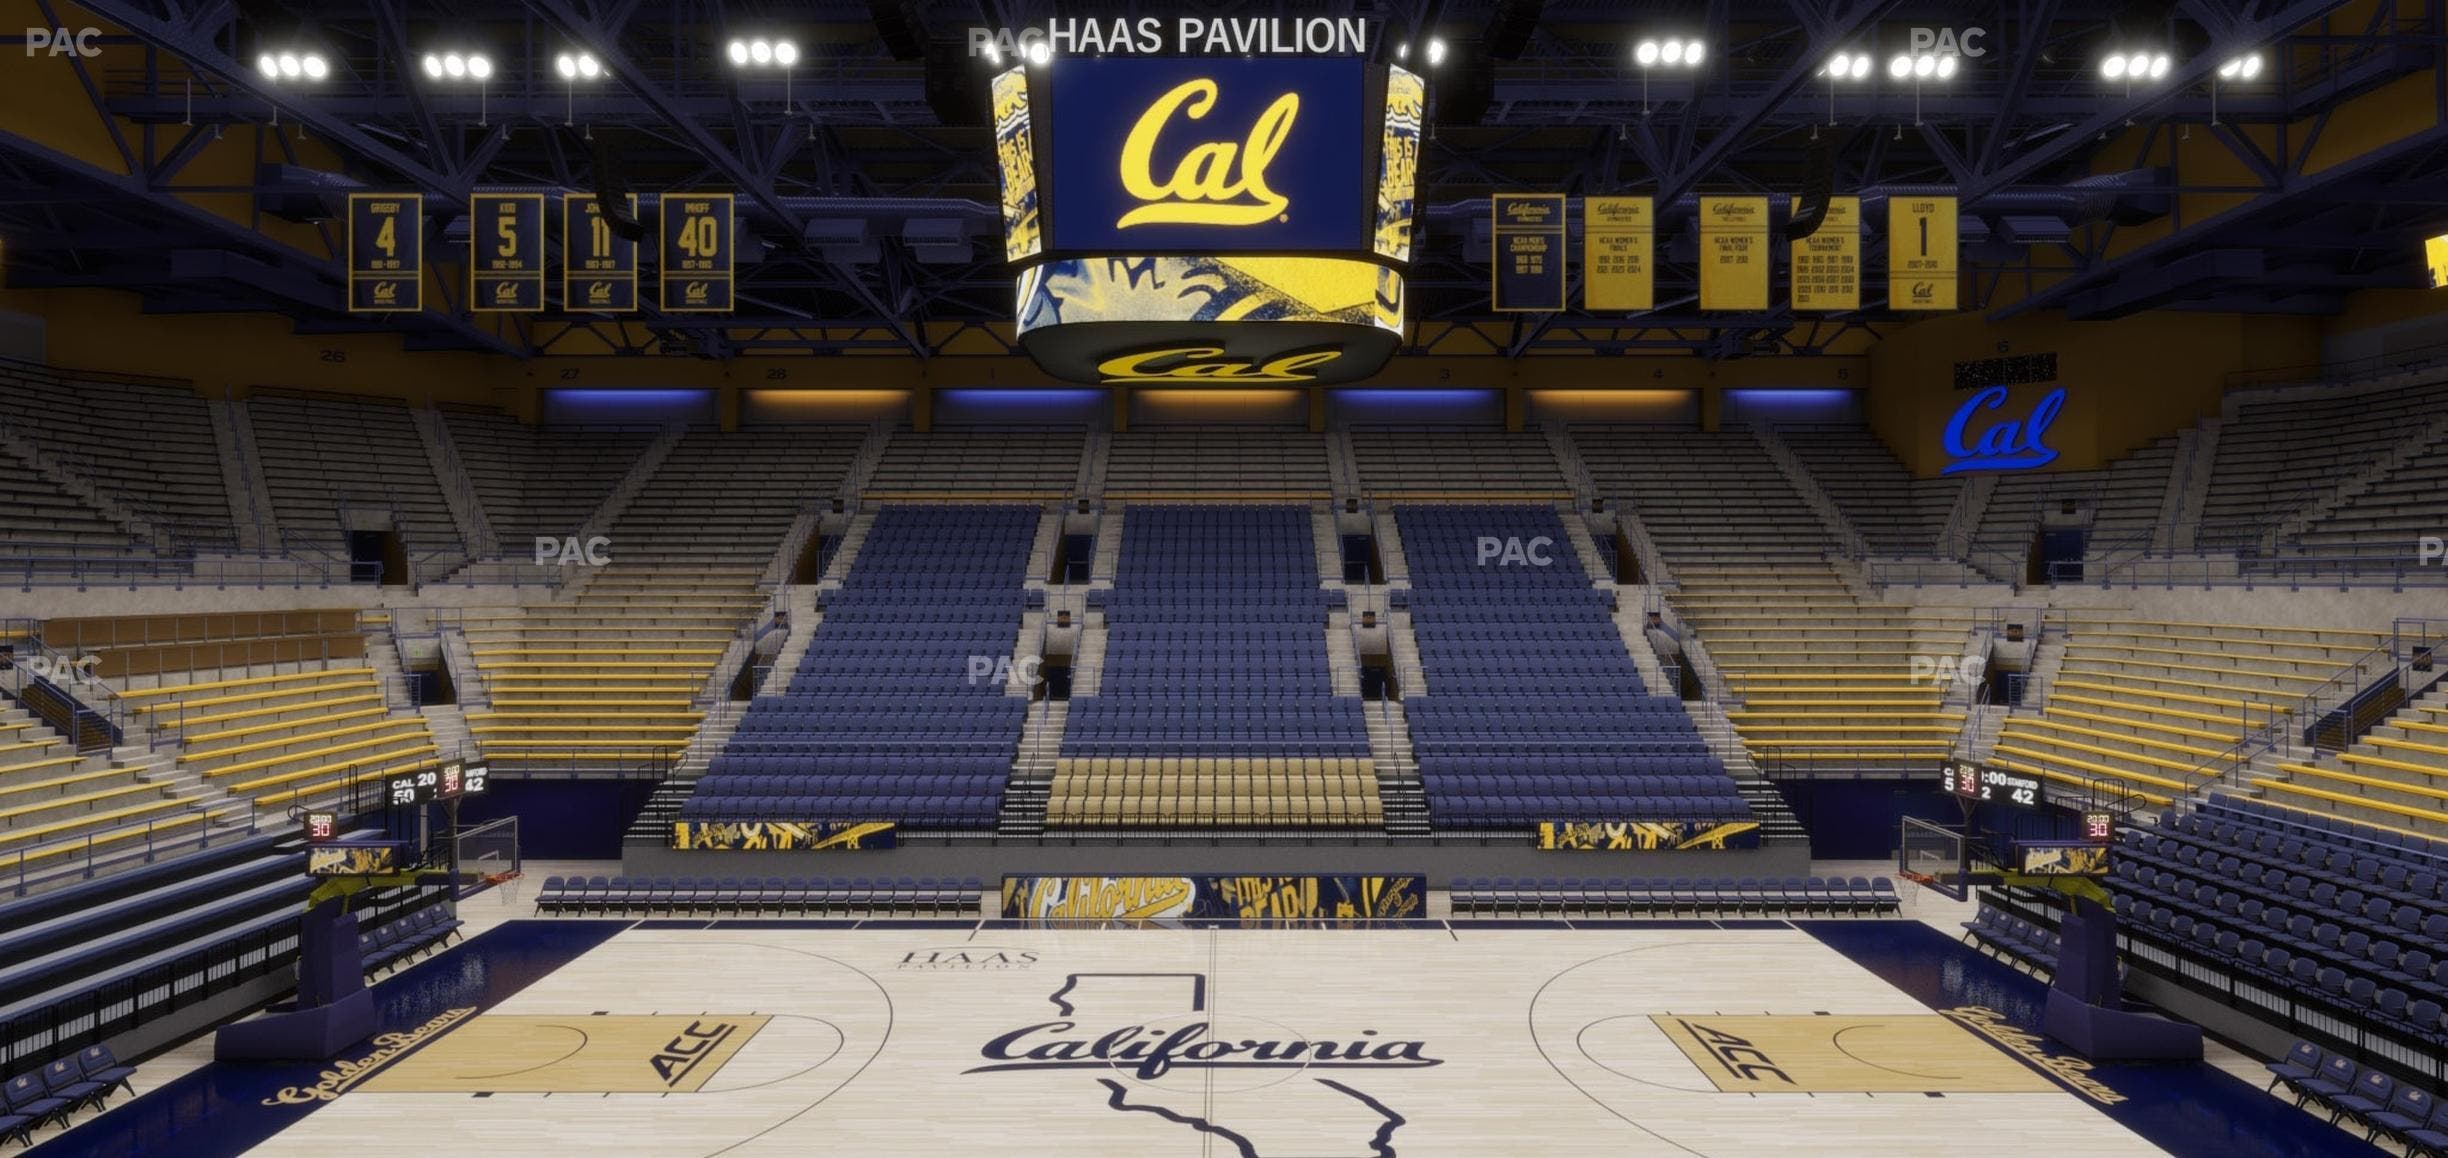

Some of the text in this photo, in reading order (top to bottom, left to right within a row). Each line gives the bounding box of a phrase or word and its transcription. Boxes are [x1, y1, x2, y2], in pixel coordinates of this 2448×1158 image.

[1049, 18, 1365, 53] HAAS PAVILION
[1116, 78, 1299, 229] Cal
[376, 217, 395, 257] 4
[498, 216, 517, 257] 5
[592, 216, 610, 257] 11
[678, 216, 718, 257] 40
[1920, 217, 1927, 257] 1
[374, 281, 397, 299] Cal
[496, 281, 519, 299] Cal
[589, 281, 612, 299] Cal
[685, 281, 709, 299] Cal
[1912, 282, 1934, 298] Cal
[1098, 347, 1342, 383] Cal
[1940, 385, 2067, 475] Cal
[392, 779, 416, 790] CAL
[464, 778, 485, 792] 42
[1944, 777, 2035, 806] 5 2 42
[1982, 771, 2039, 791] :00 STANFORD
[312, 823, 330, 837] 30
[2089, 823, 2108, 837] 30
[901, 952, 1040, 963] HAAS
[261, 1007, 477, 1105] Golden Bears
[650, 1020, 732, 1083] ACC
[962, 1021, 1445, 1081] California
[1688, 1021, 1798, 1086] ACC
